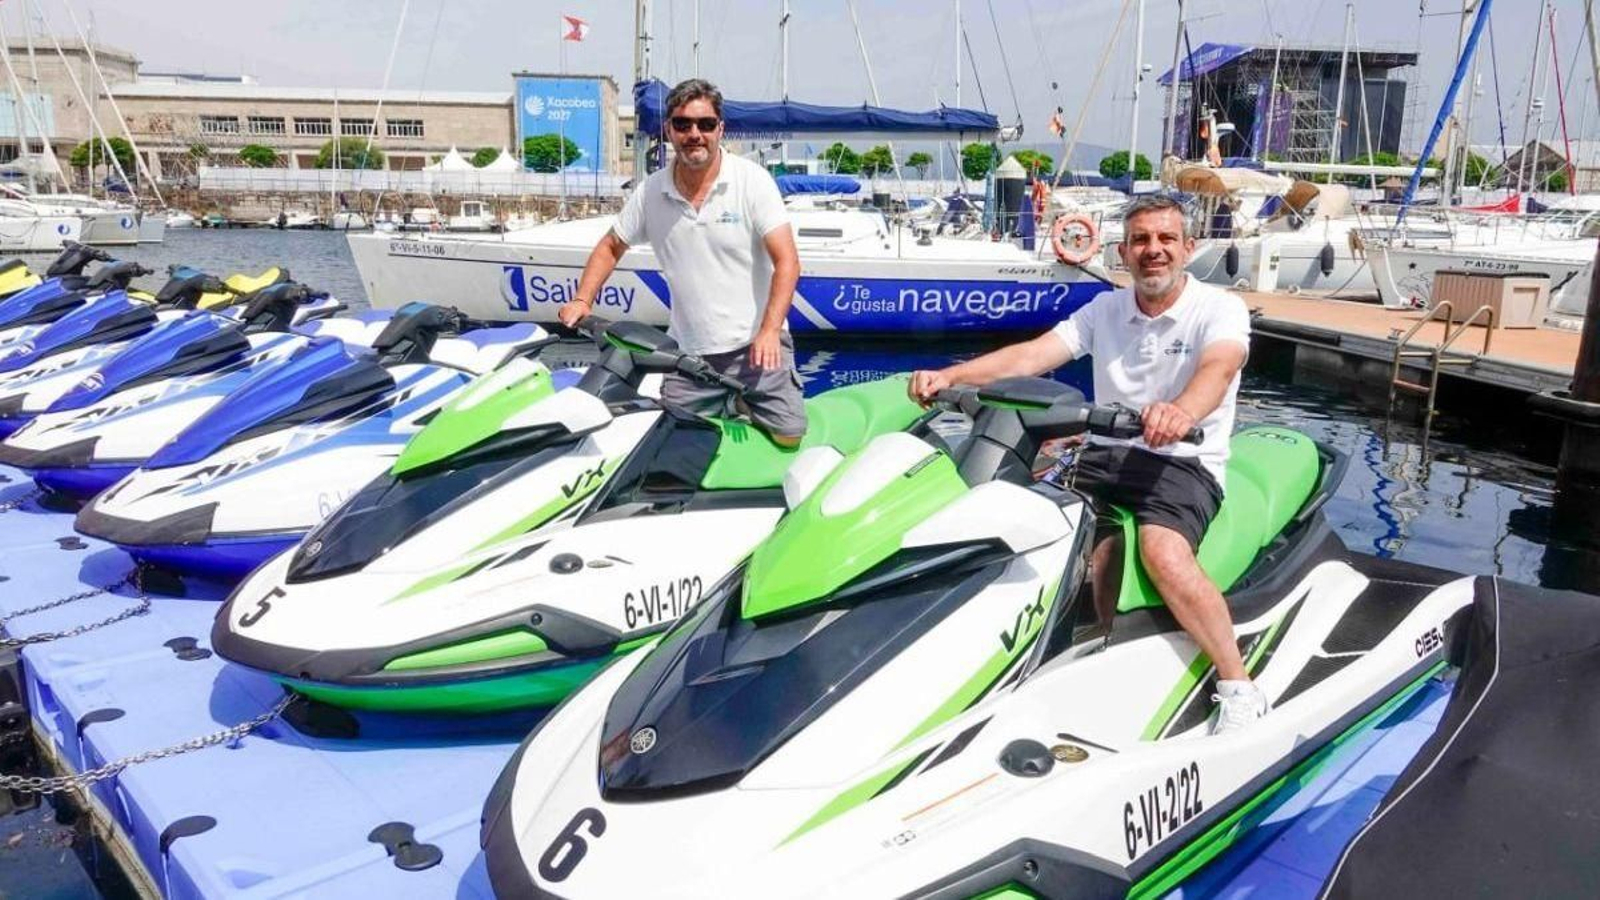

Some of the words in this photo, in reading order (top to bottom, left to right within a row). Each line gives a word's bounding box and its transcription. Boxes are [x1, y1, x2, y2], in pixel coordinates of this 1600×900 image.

[547, 96, 597, 108] Xacobeo
[852, 299, 896, 315] gusta
[898, 283, 1070, 319] navegar?
[561, 458, 606, 499] VX
[238, 586, 287, 628] 5
[624, 575, 702, 629] 6-VI-1/22
[1000, 584, 1045, 653] VX
[1124, 761, 1203, 860] 6-VI-2/22
[538, 807, 607, 883] 6
